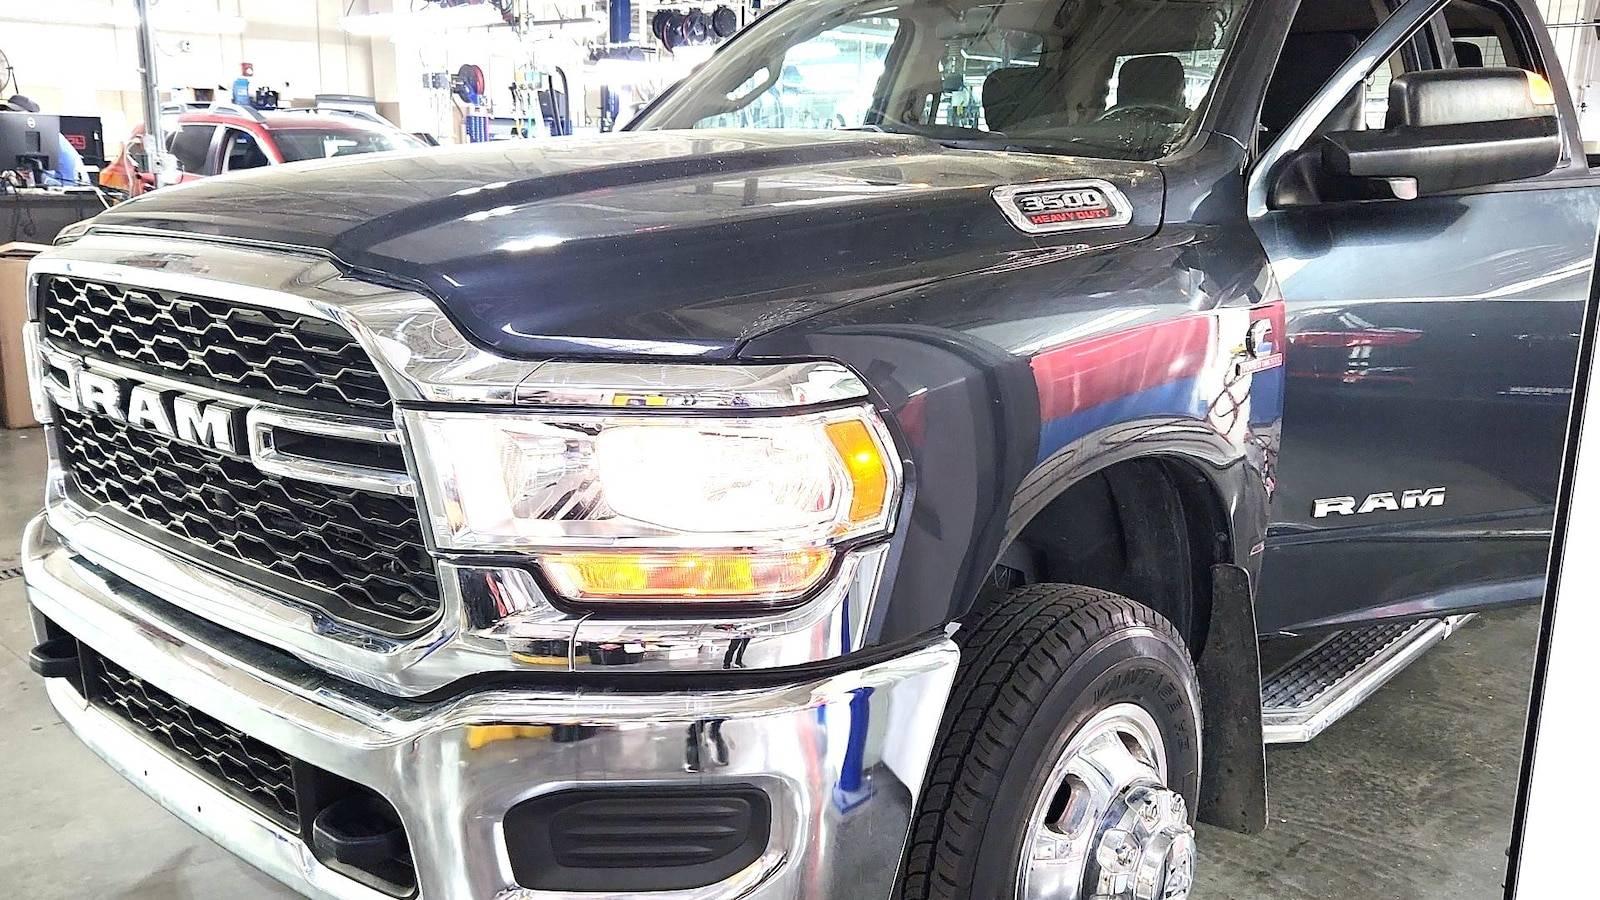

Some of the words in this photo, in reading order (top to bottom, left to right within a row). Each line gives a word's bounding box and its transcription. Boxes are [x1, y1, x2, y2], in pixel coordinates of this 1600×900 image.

[1021, 191, 1103, 211] 3500
[1031, 213, 1075, 224] HEAVY
[1077, 208, 1109, 219] DUTY
[78, 370, 235, 453] RAM
[1311, 486, 1446, 518] RAM
